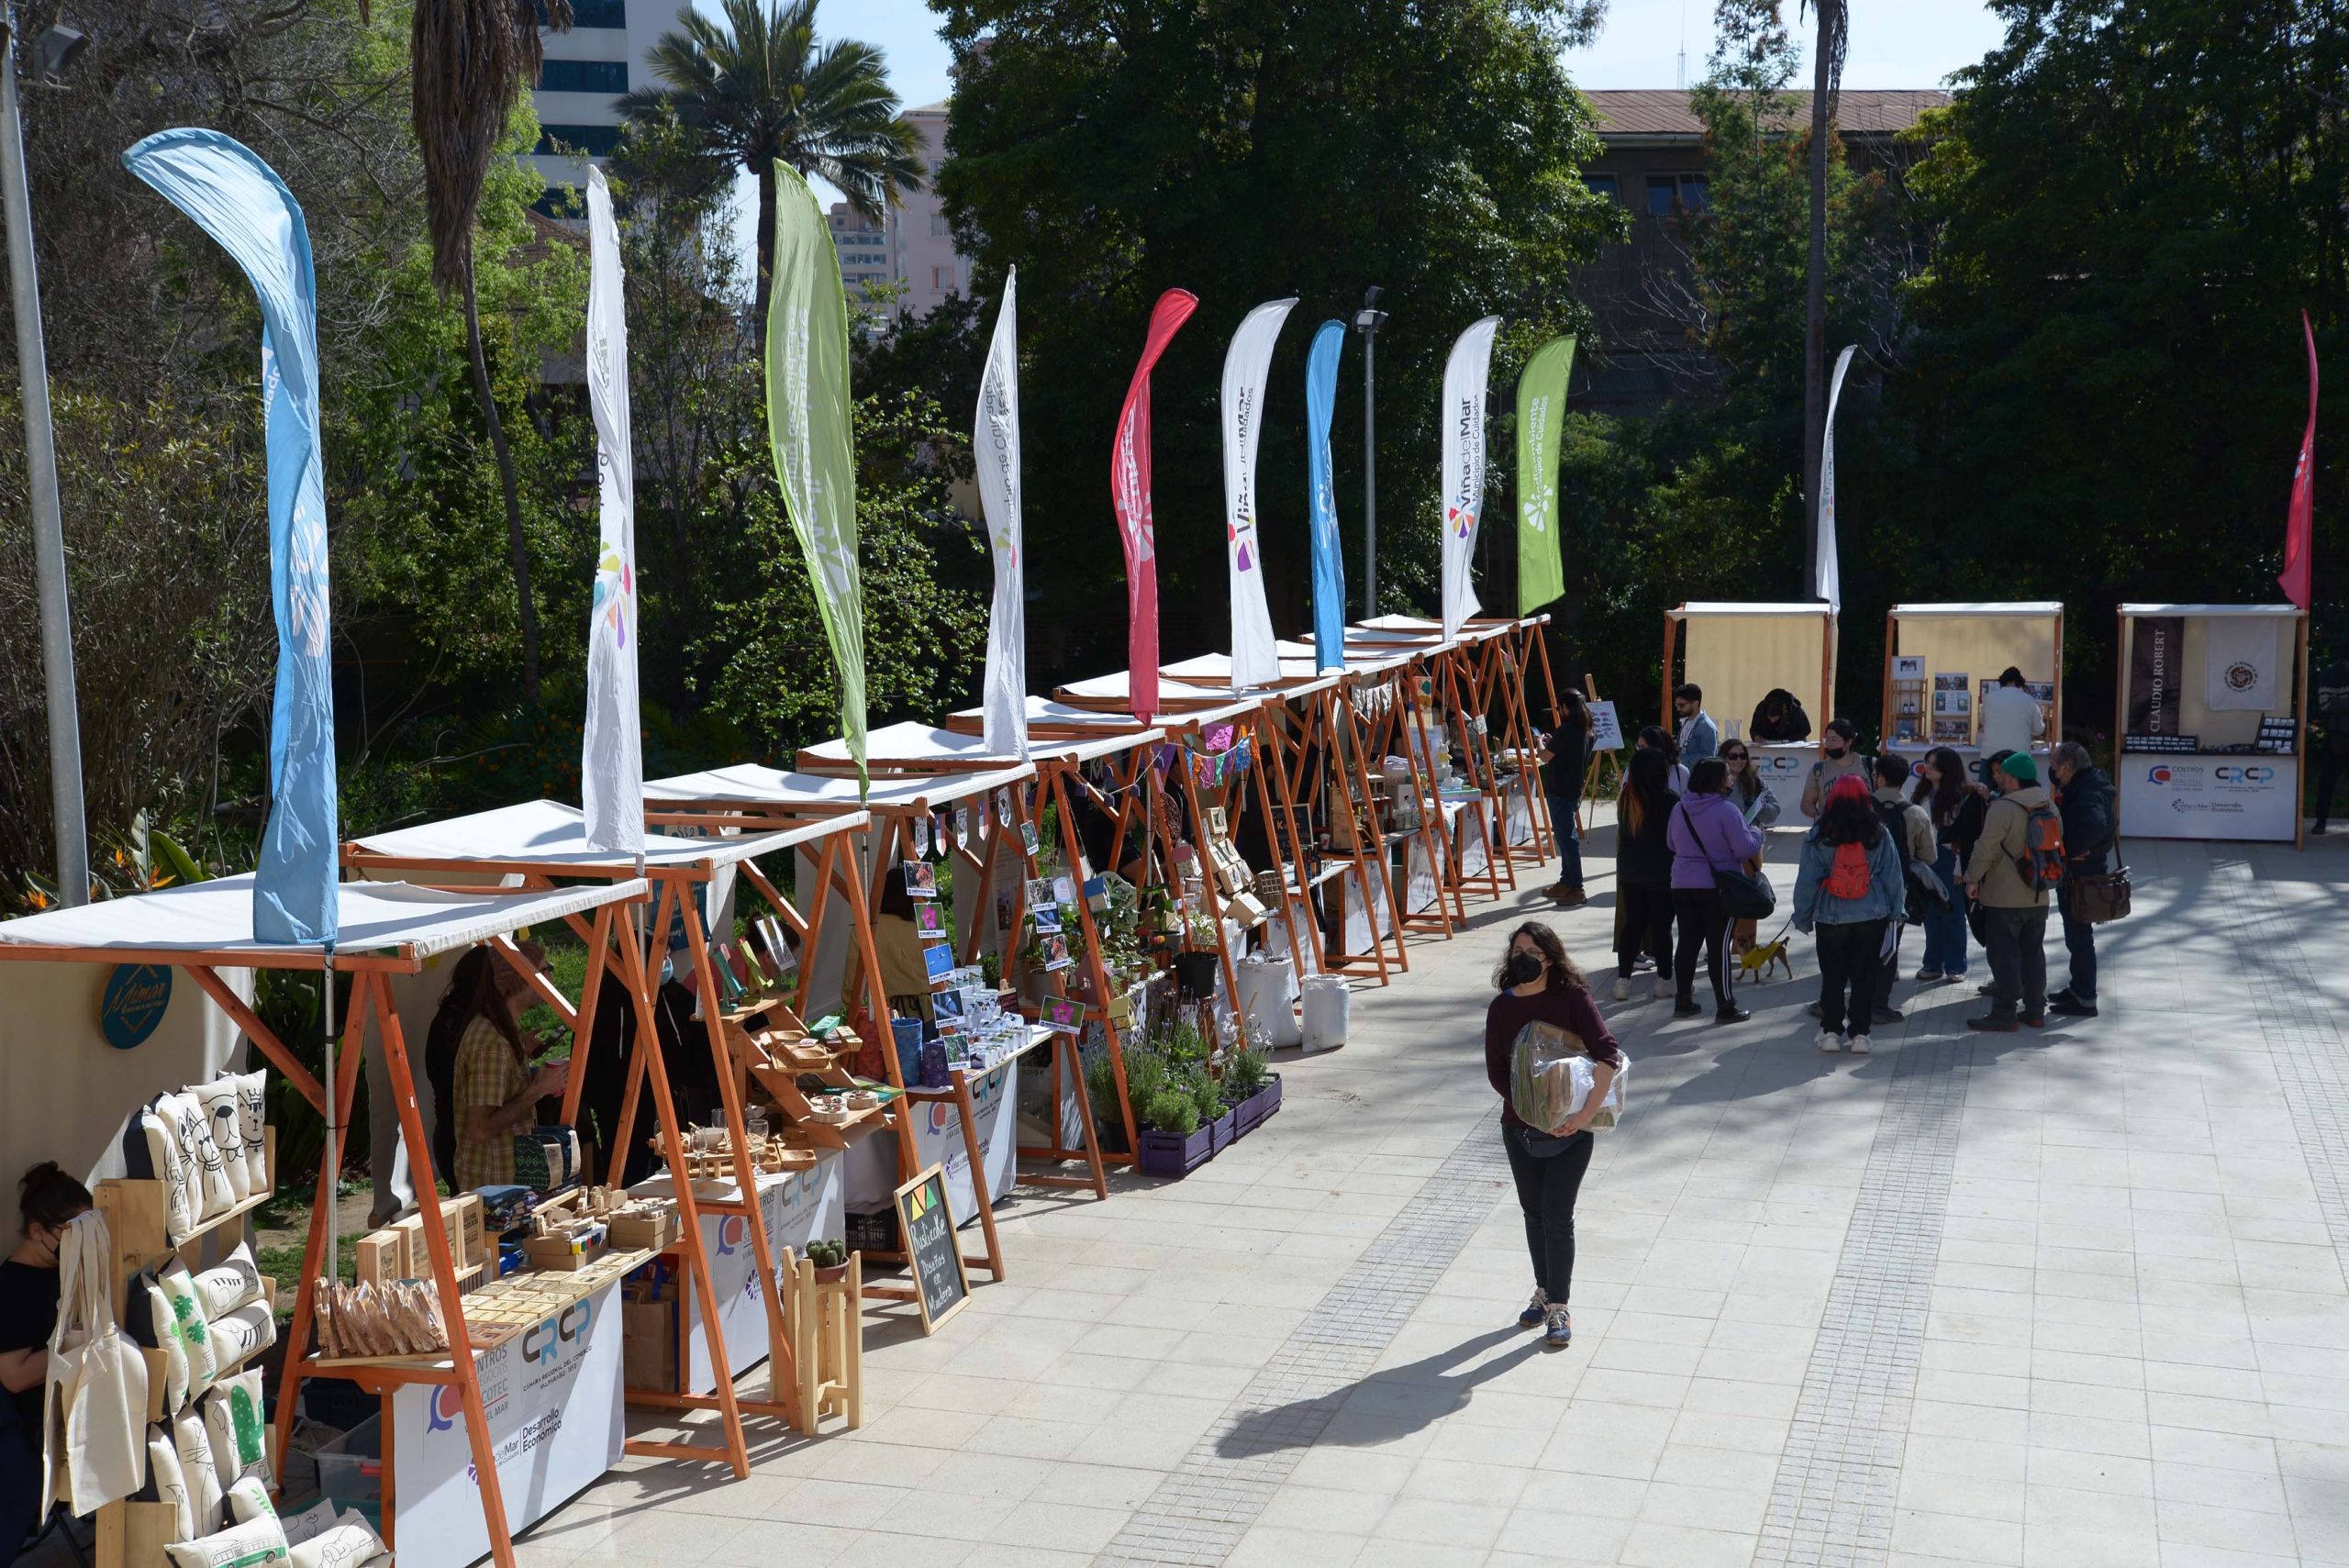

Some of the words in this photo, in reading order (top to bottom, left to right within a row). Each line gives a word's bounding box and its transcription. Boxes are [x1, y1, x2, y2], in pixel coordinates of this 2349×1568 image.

[1460, 397, 1471, 509] ViñadelMar
[1473, 441, 1480, 453] de
[1472, 455, 1481, 502] Municipio
[2154, 628, 2165, 676] ROBERT
[2150, 678, 2164, 732] CLAUDIO
[920, 1253, 946, 1280] Diseños
[933, 1273, 941, 1285] en
[522, 1297, 591, 1366] CRCP
[475, 1344, 507, 1373] NTROS
[479, 1359, 508, 1386] EGOCIOS
[481, 1378, 508, 1404] COTEC
[494, 1401, 508, 1418] MAR
[522, 1407, 560, 1439] Desarrollo
[495, 1439, 519, 1462] delMar
[522, 1419, 562, 1453] Económico
